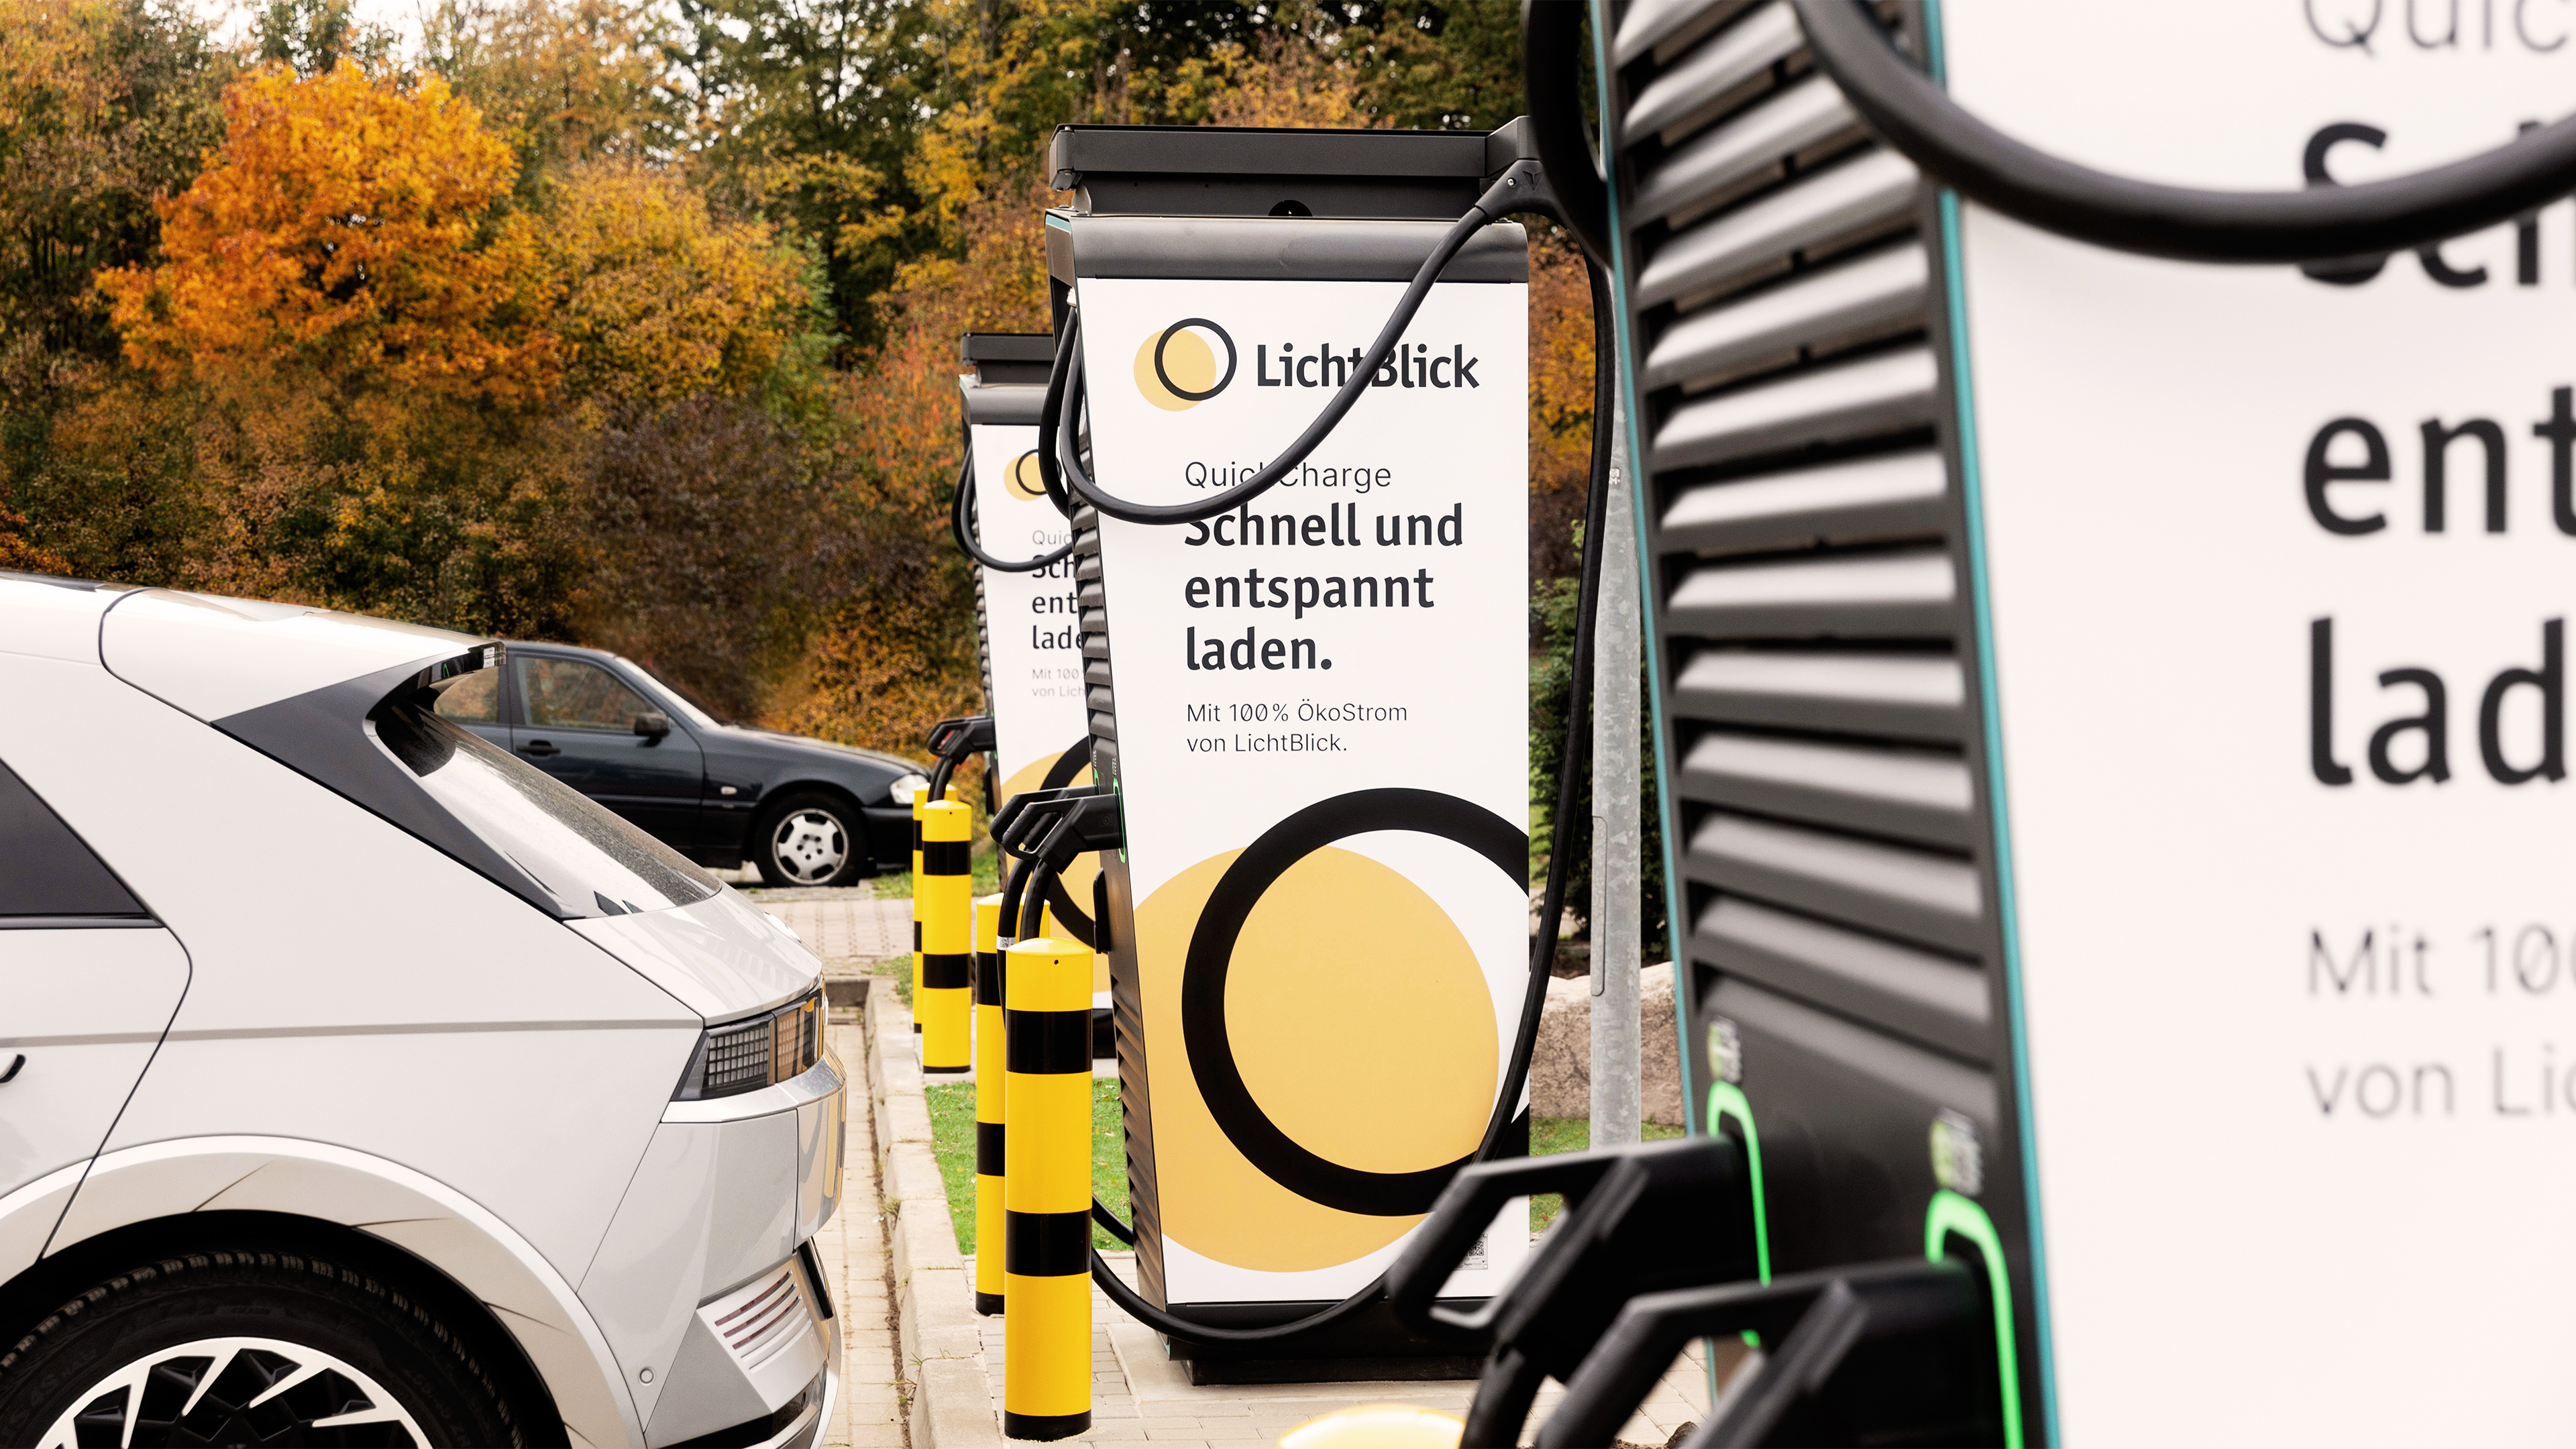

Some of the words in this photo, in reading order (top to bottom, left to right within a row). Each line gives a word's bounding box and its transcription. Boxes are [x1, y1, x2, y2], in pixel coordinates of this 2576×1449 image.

[1258, 342, 1480, 388] LichtBlick
[2304, 386, 2576, 537] ent
[1185, 502, 1361, 547] Schnell
[1377, 502, 1463, 546] und
[1032, 592, 1077, 614] ent
[1185, 568, 1434, 619] entspannt
[1187, 627, 1332, 670] laden.
[1032, 668, 1051, 679] Mit
[1032, 688, 1055, 697] von
[1187, 703, 1221, 722] Mit
[1298, 698, 1407, 722] ÖkoStrom
[2310, 617, 2567, 786] lad
[1187, 738, 1226, 753] von
[1235, 733, 1347, 752] LichtBlick.
[2308, 924, 2434, 996] Mit
[2472, 923, 2576, 996] 10
[2306, 1062, 2455, 1120] von
